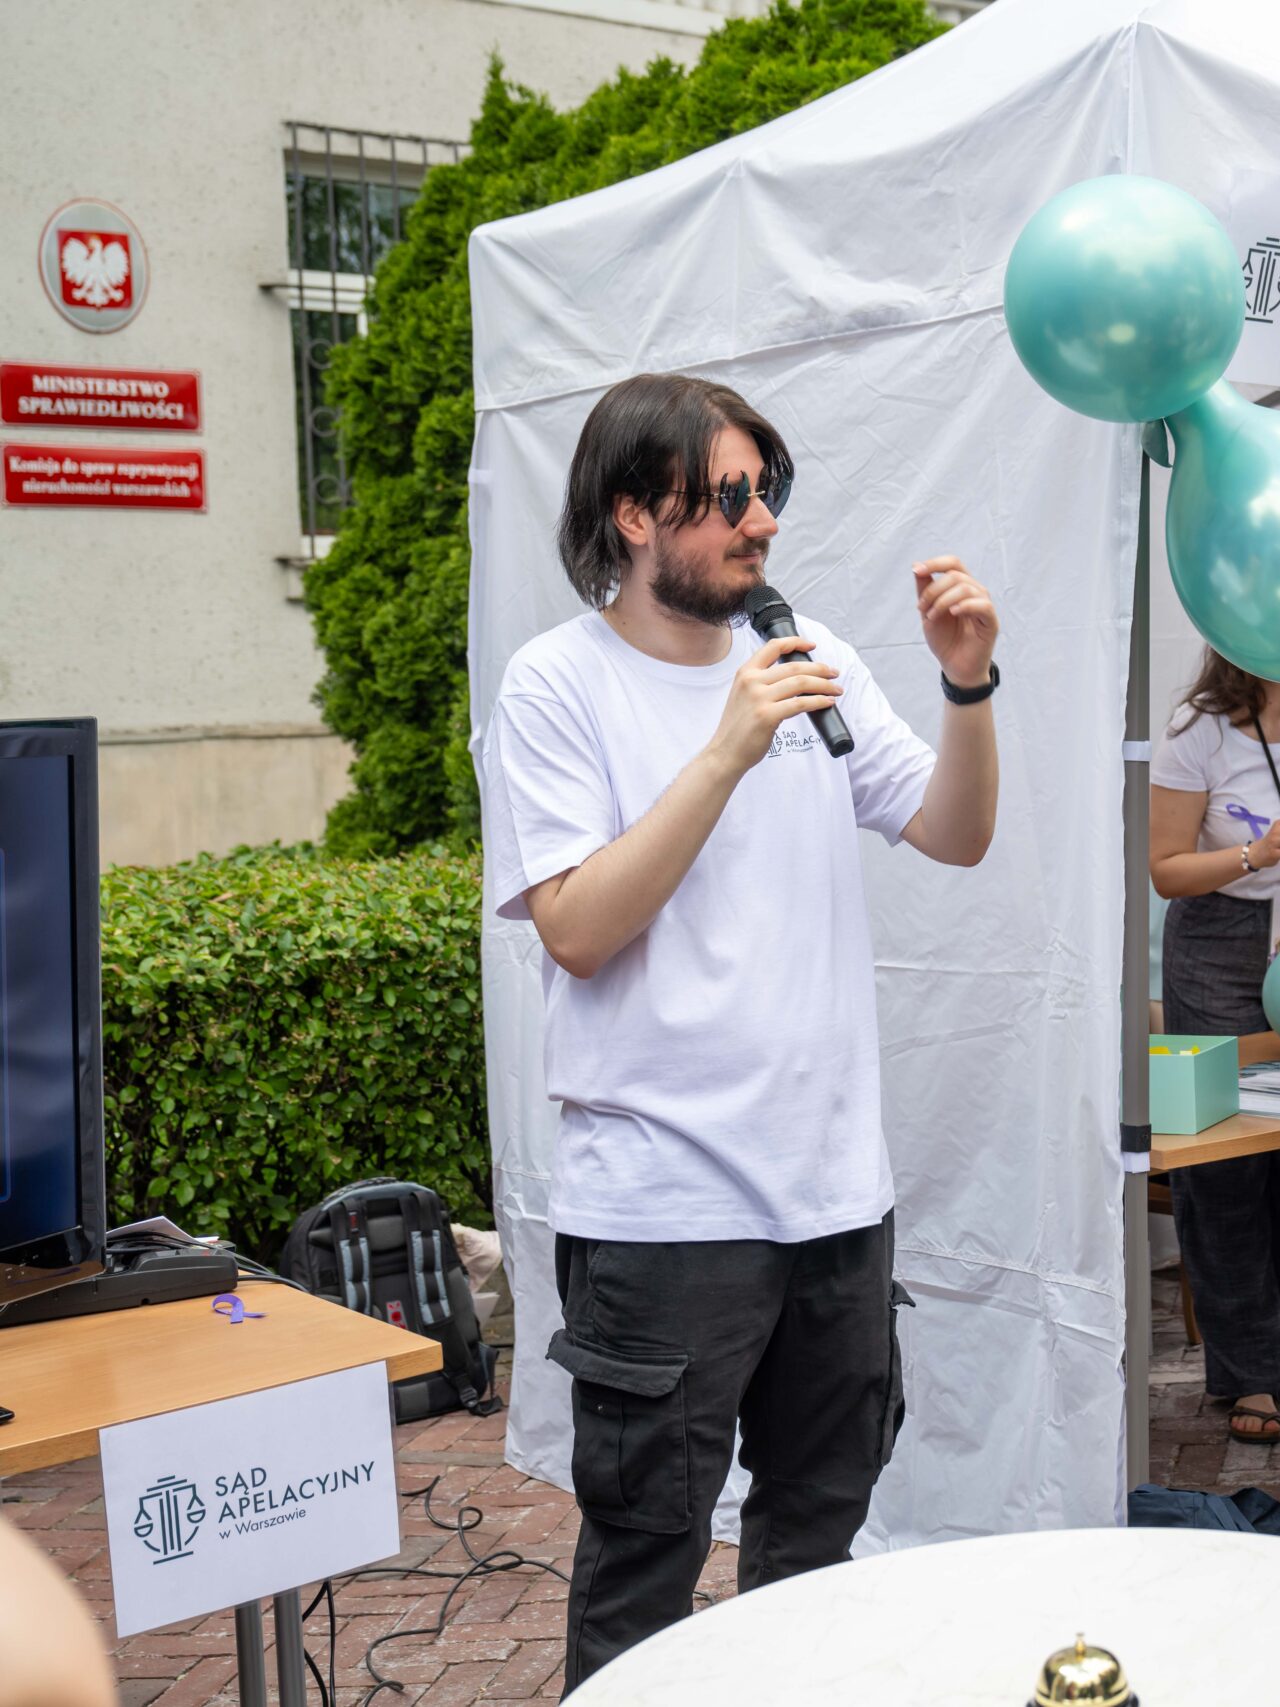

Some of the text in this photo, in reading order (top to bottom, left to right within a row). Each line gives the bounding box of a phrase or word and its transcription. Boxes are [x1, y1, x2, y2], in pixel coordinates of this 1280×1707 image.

[32, 374, 170, 398] MINISTERSTWO
[18, 396, 185, 421] SPRAWIEDLIWOŚCI
[9, 456, 61, 477] Komisja
[62, 457, 79, 474] do
[215, 1467, 267, 1497] SĄD
[218, 1461, 375, 1523] APELACYJNY
[219, 1507, 307, 1540] w Warszawie
